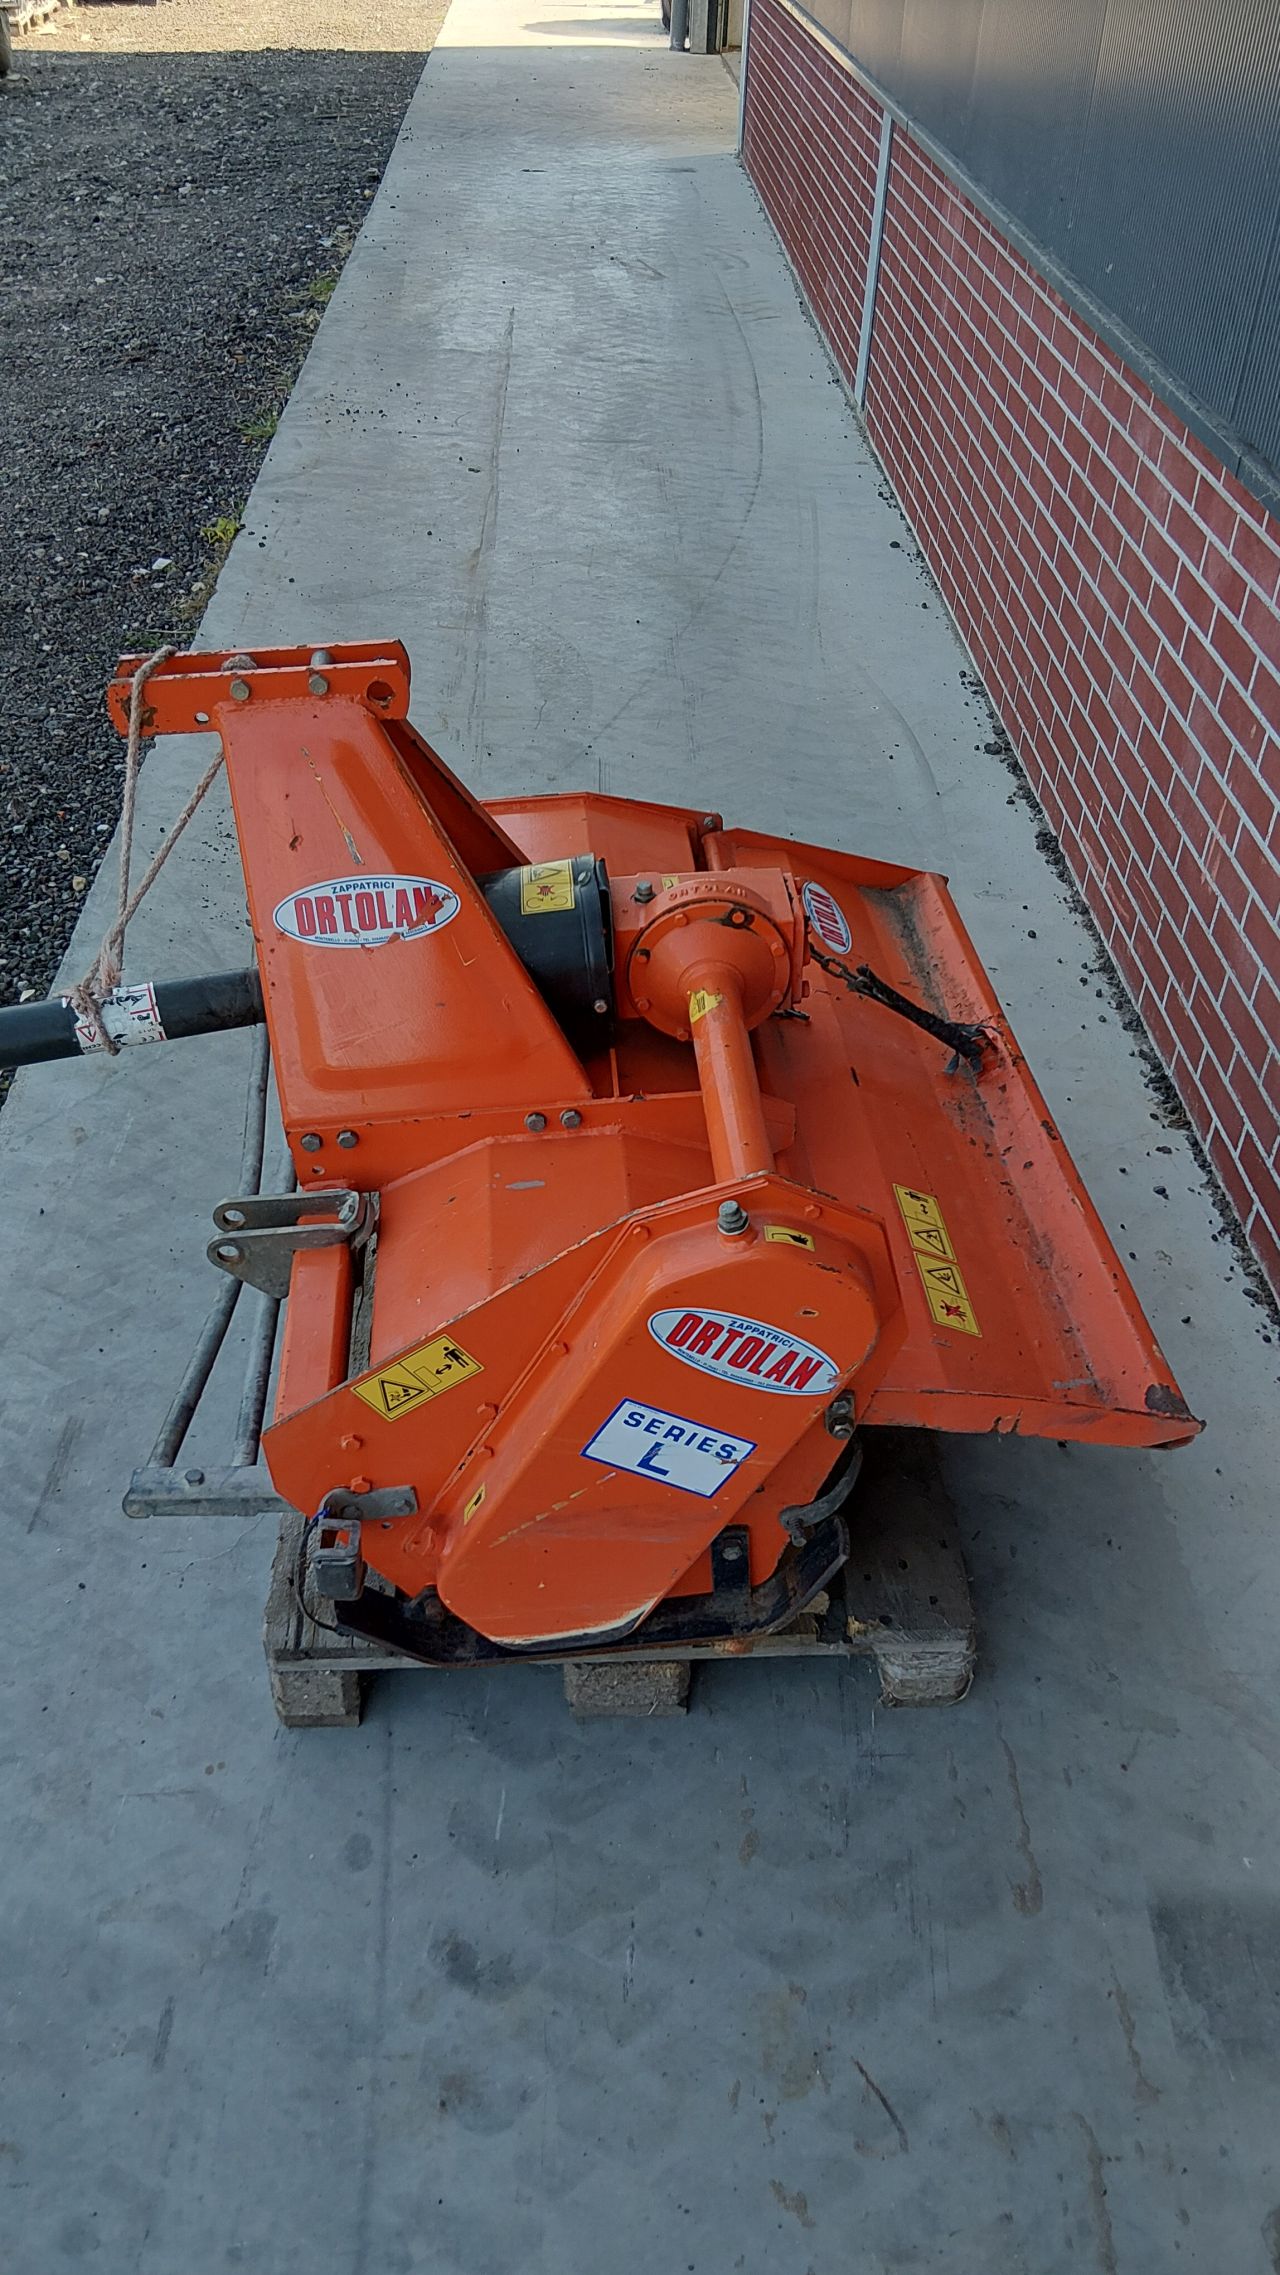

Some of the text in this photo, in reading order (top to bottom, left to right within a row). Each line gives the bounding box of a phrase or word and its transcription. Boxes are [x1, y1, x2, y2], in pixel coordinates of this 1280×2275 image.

[294, 886, 437, 937] ORTOLAN
[331, 881, 395, 895] ZAPPATRICI
[807, 887, 847, 948] ORTOLAN
[665, 1312, 825, 1391] ORTOLAN
[728, 1320, 795, 1349] ZAPPATRICI
[623, 1411, 738, 1459] SERIES
[636, 1441, 670, 1477] L
